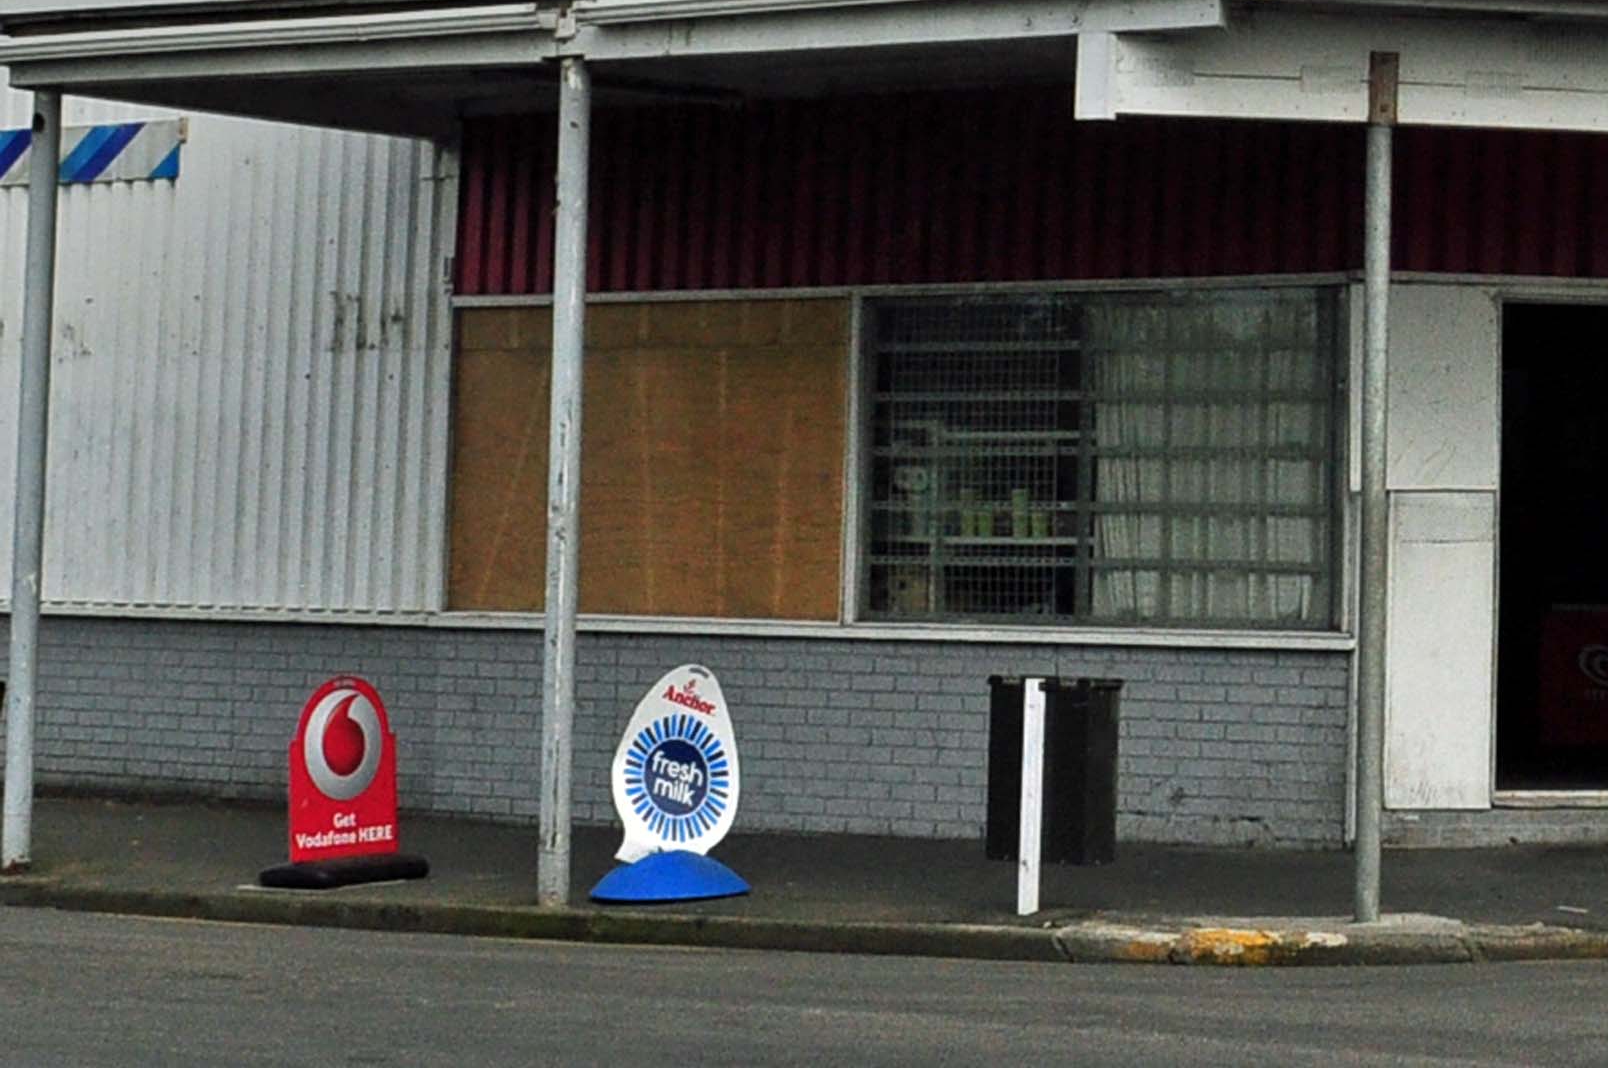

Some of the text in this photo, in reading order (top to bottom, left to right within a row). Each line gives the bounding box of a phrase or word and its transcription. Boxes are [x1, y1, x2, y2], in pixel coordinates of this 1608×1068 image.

[662, 684, 716, 714] Anchor
[651, 750, 704, 787] fresh
[653, 776, 696, 807] milk
[333, 812, 357, 829] Get
[295, 824, 393, 849] Vodafone HERE
